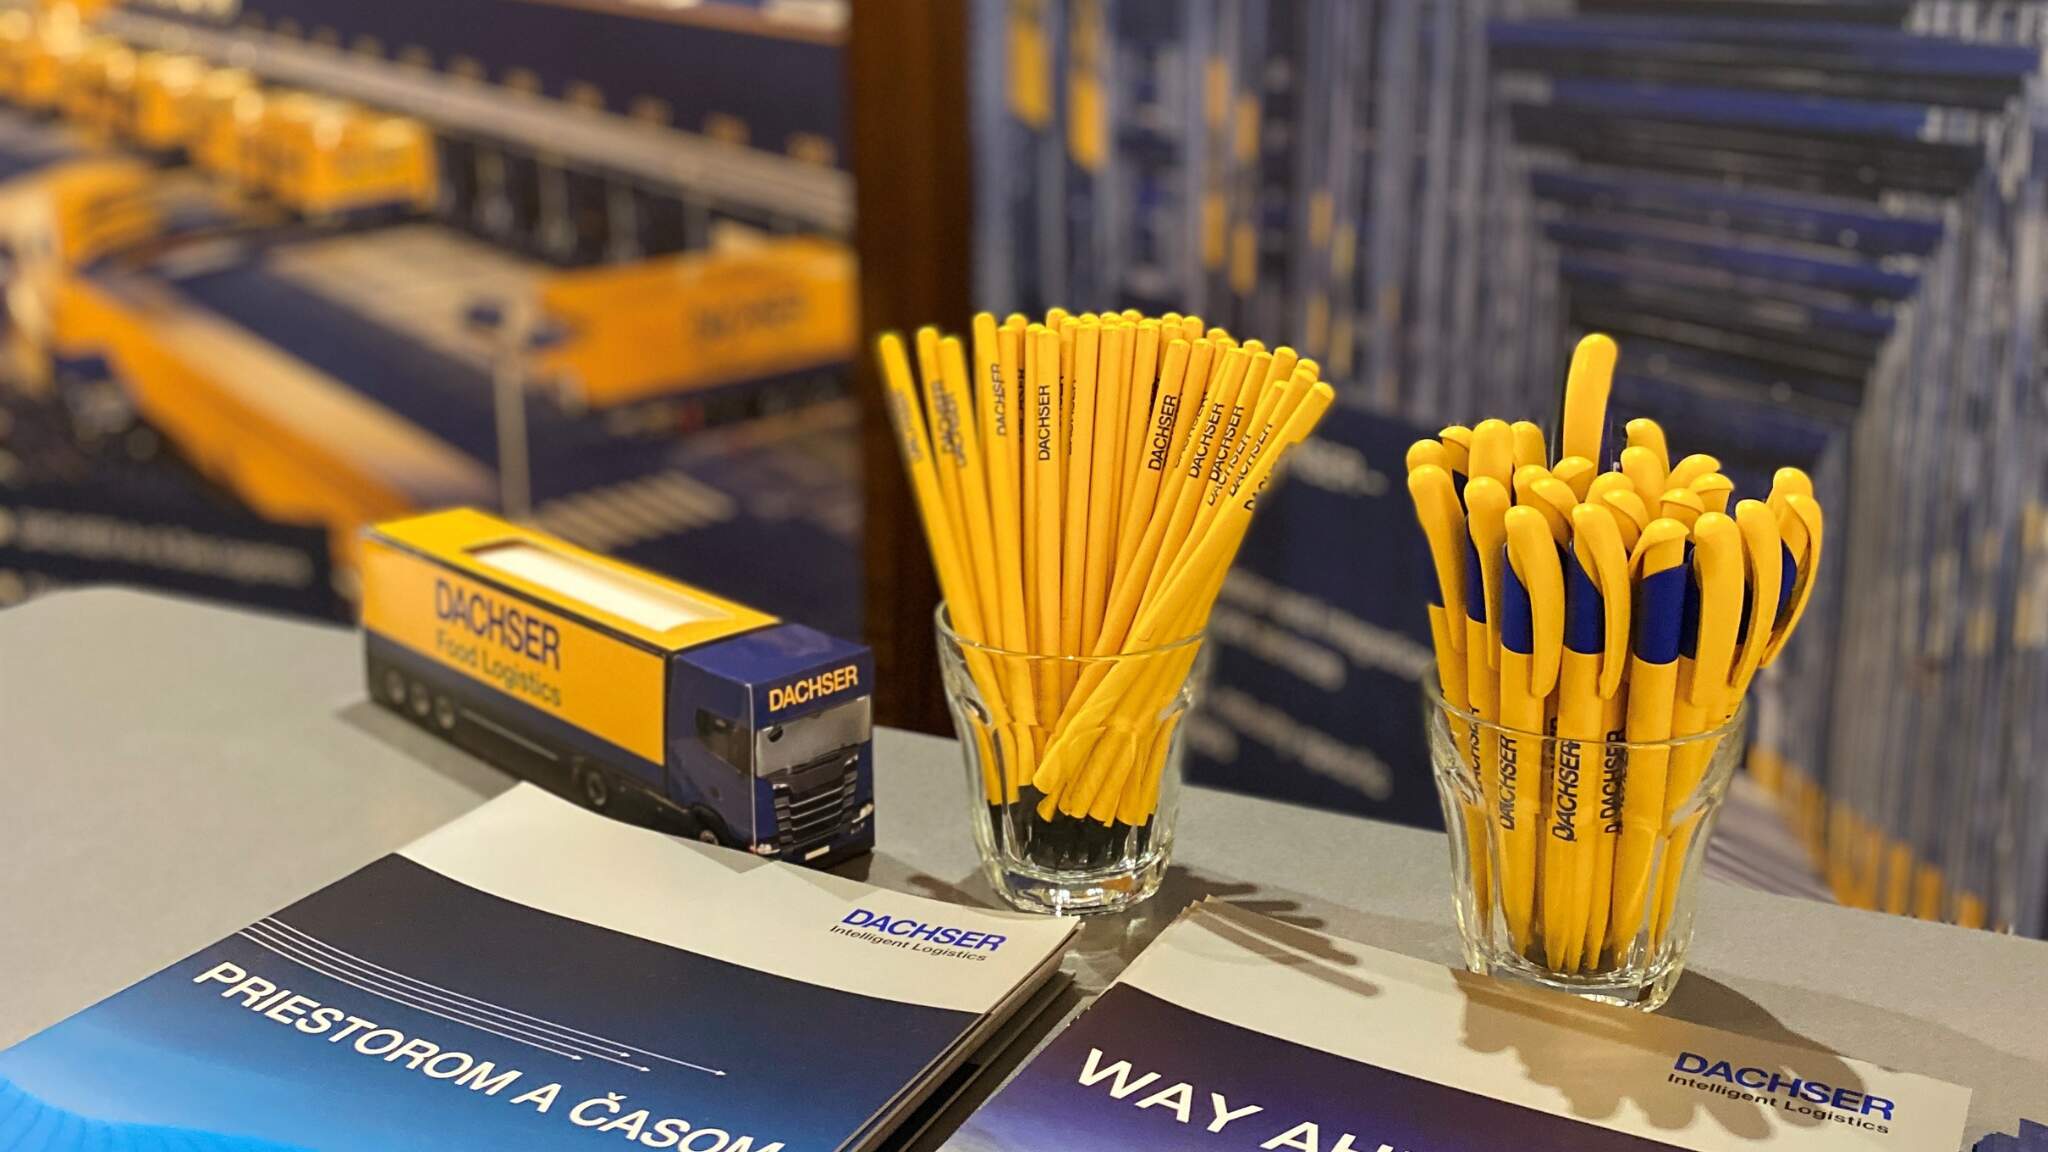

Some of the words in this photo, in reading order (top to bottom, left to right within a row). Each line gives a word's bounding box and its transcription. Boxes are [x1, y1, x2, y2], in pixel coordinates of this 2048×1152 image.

[1038, 385, 1051, 461] DACHSER
[1148, 394, 1178, 471] DACHSER
[1188, 402, 1225, 479] DACHSER
[1209, 406, 1244, 482] DACHSER
[435, 578, 560, 671] DACHSER
[436, 627, 477, 668] Food
[482, 650, 561, 707] Logistics
[768, 664, 859, 712] DACHSER
[1551, 740, 1581, 842] DACHSER
[830, 924, 910, 949] Intelligent
[911, 942, 988, 962] Logistics
[841, 908, 1007, 951] DACHSER
[192, 961, 522, 1097] PRIESTOROM
[510, 1083, 563, 1114] A
[1078, 1047, 1265, 1133] WAY
[1667, 1072, 1780, 1107] Intelligent
[1783, 1100, 1890, 1135] Logistics
[1673, 1051, 1896, 1121] DACHSER
